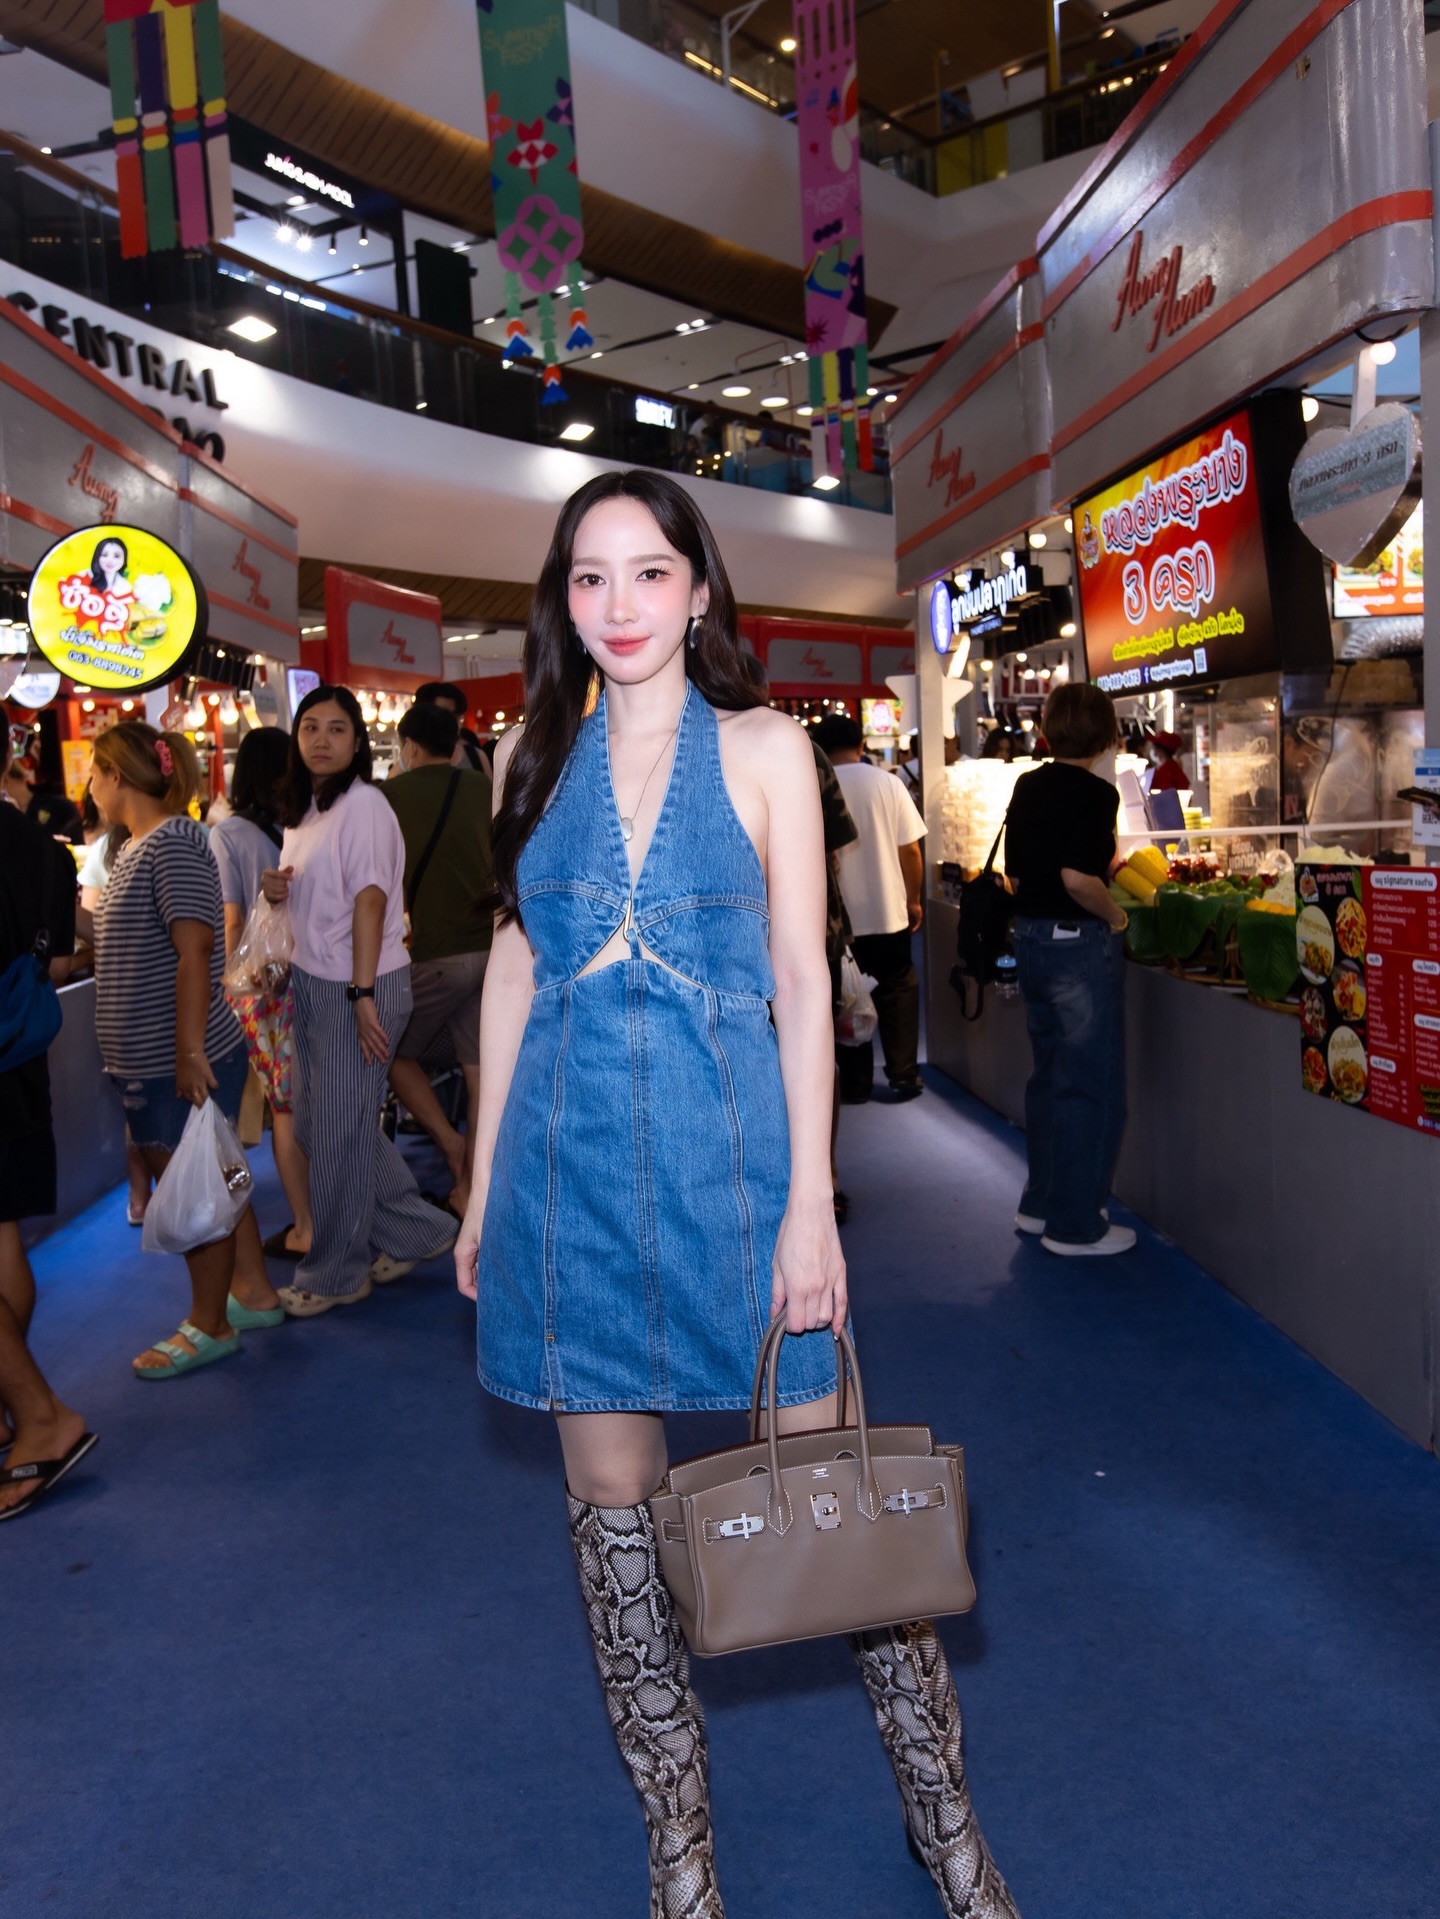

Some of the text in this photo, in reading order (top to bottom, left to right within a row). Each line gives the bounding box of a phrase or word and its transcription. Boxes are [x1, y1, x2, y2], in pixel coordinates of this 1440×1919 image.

[1123, 541, 1214, 624] 3 ครก
[1384, 875, 1414, 887] signature
